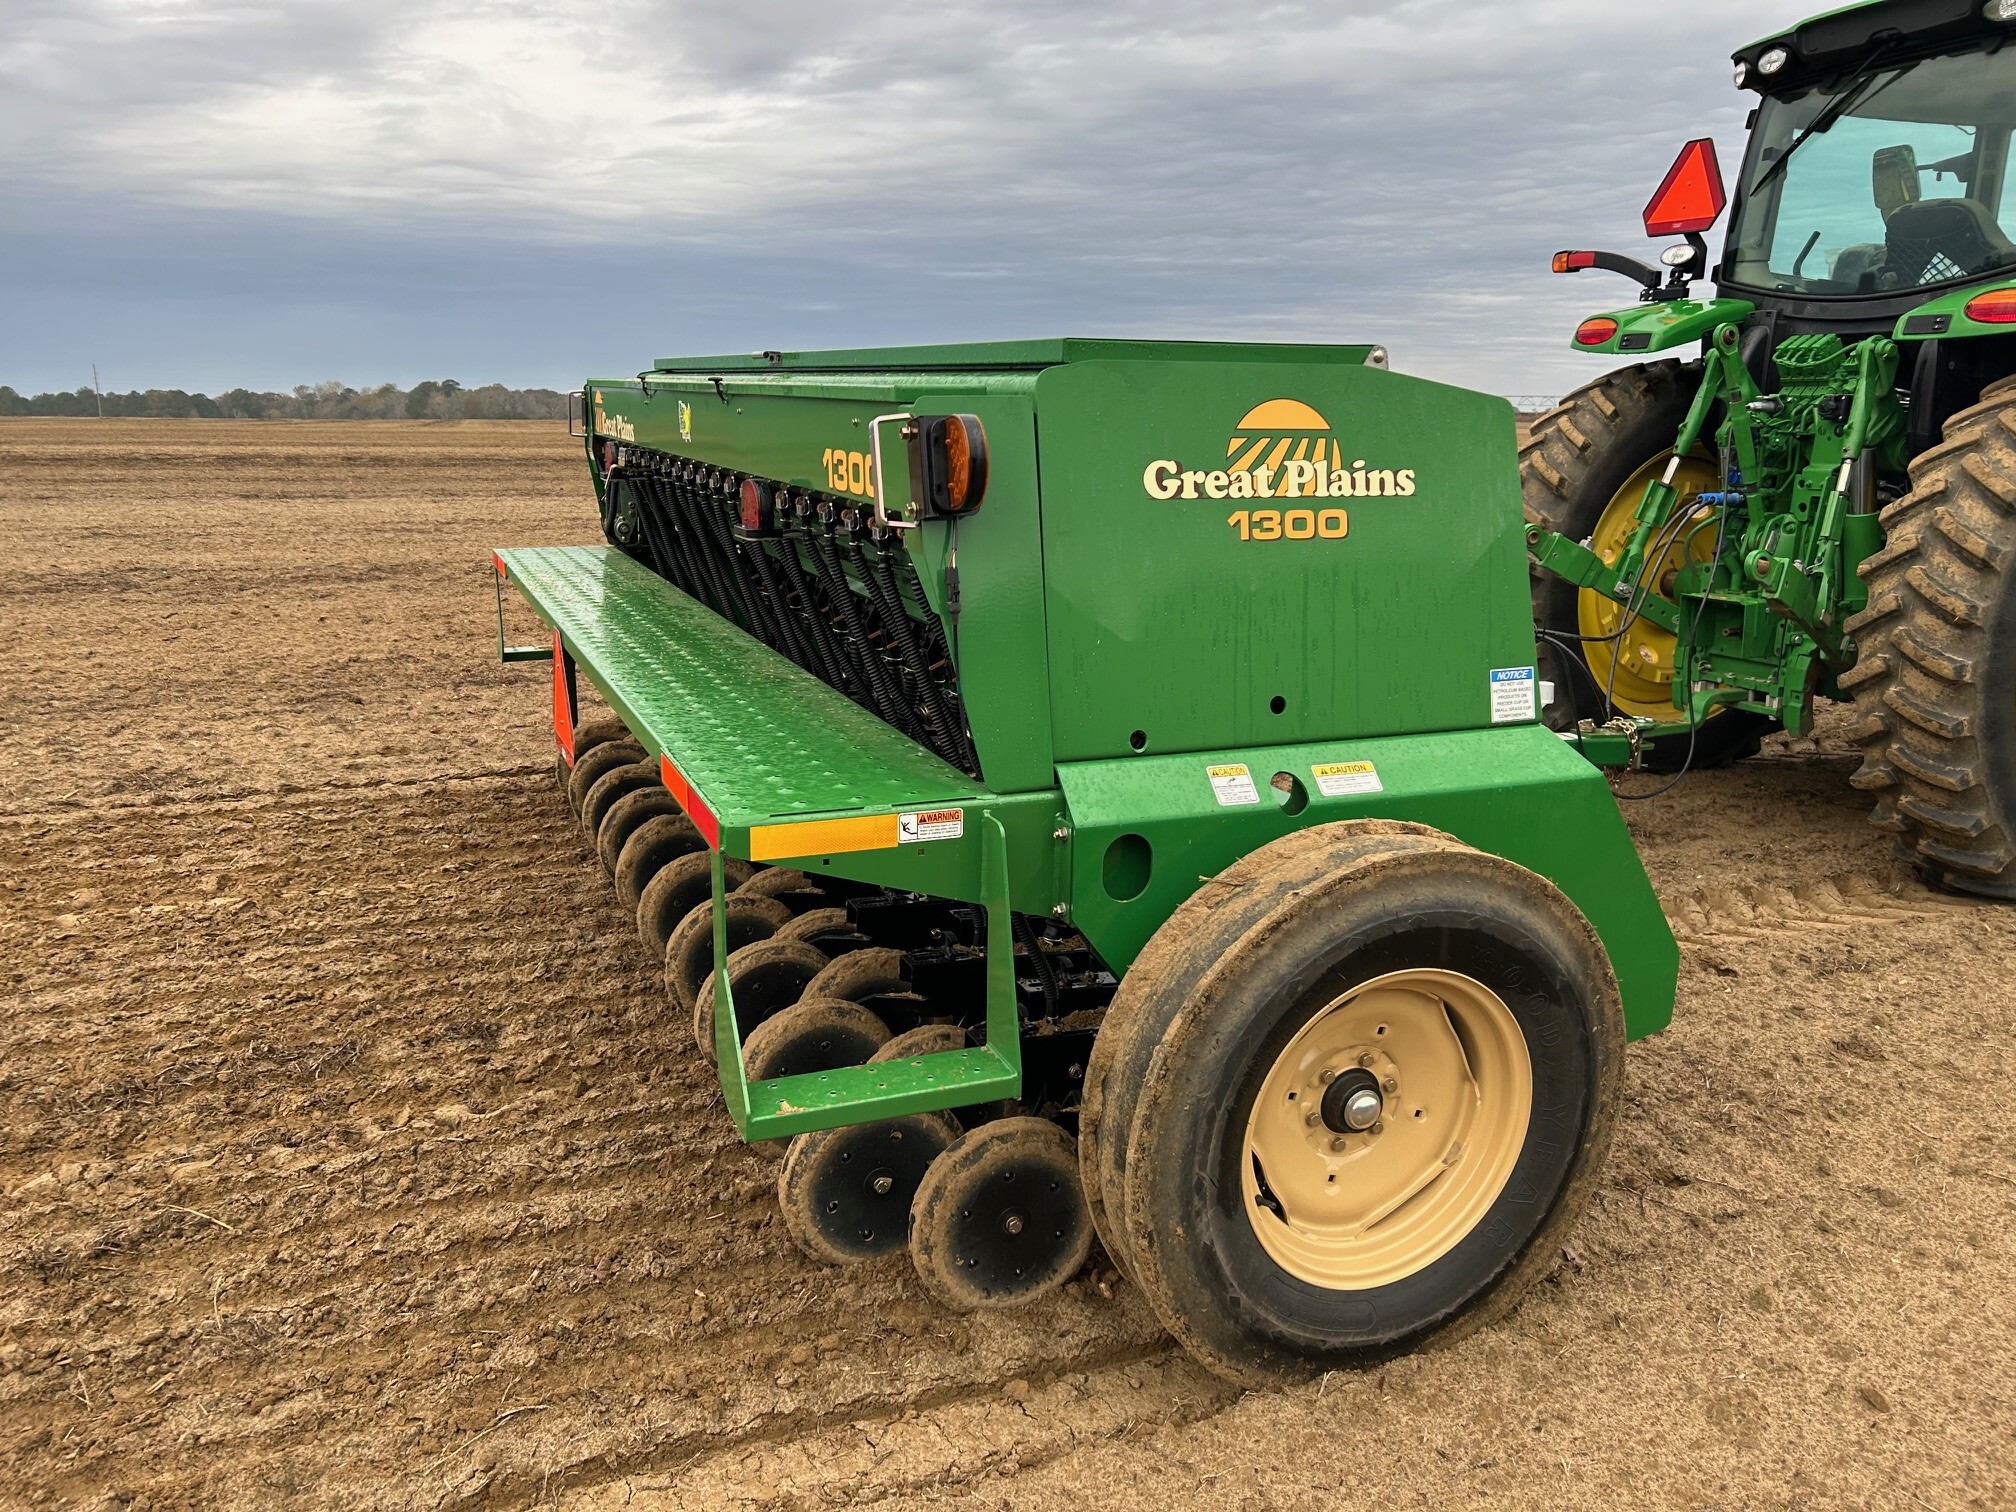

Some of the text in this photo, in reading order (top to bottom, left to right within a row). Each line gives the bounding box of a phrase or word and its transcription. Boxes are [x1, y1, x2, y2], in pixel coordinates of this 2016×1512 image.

[602, 411, 635, 442] Great Plains
[1143, 459, 1416, 500] Great Plains
[1227, 508, 1349, 541] 1300
[1497, 670, 1529, 680] NOTICE
[1218, 767, 1245, 776] CAUTION
[1329, 764, 1367, 774] CAUTION
[926, 811, 960, 822] WARNING
